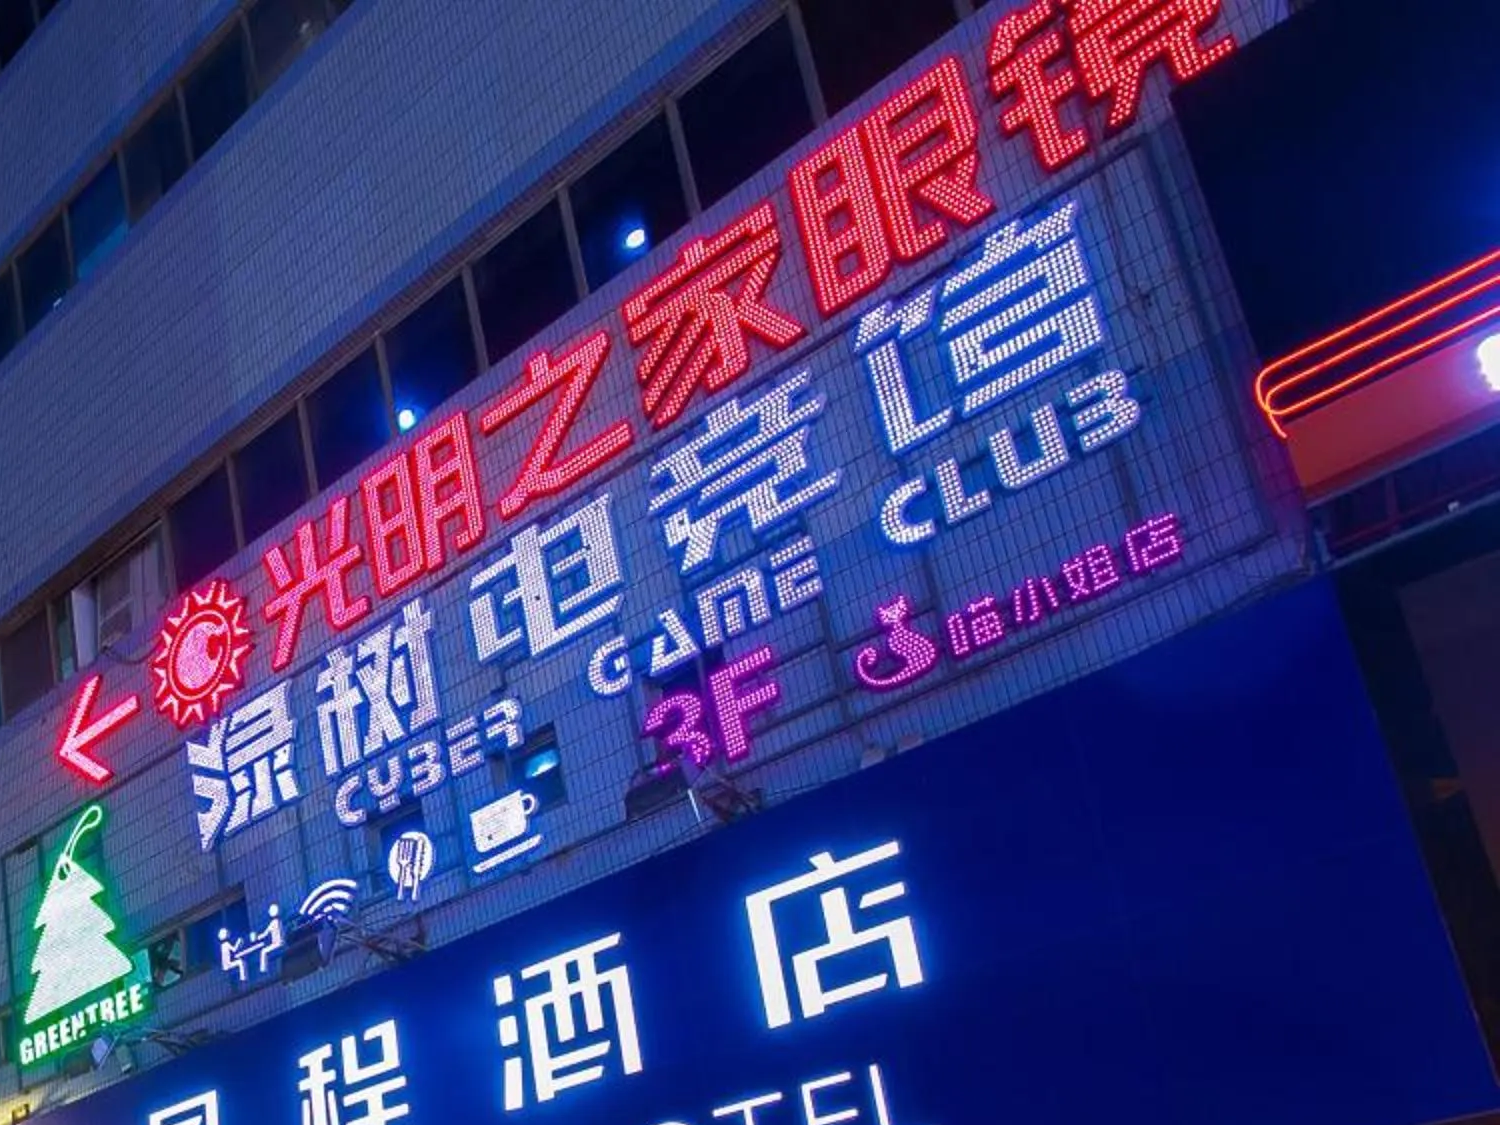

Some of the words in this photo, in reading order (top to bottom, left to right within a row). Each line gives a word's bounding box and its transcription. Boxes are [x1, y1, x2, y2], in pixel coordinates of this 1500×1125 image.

[186, 202, 1104, 850] 绿树电竞馆
[264, 0, 1235, 672] 光明之家眼镜
[334, 697, 525, 828] CYBER
[587, 535, 821, 697] GAME
[880, 369, 1142, 546] CLUB
[643, 644, 781, 774] 3F
[18, 988, 145, 1065] GREENTREE
